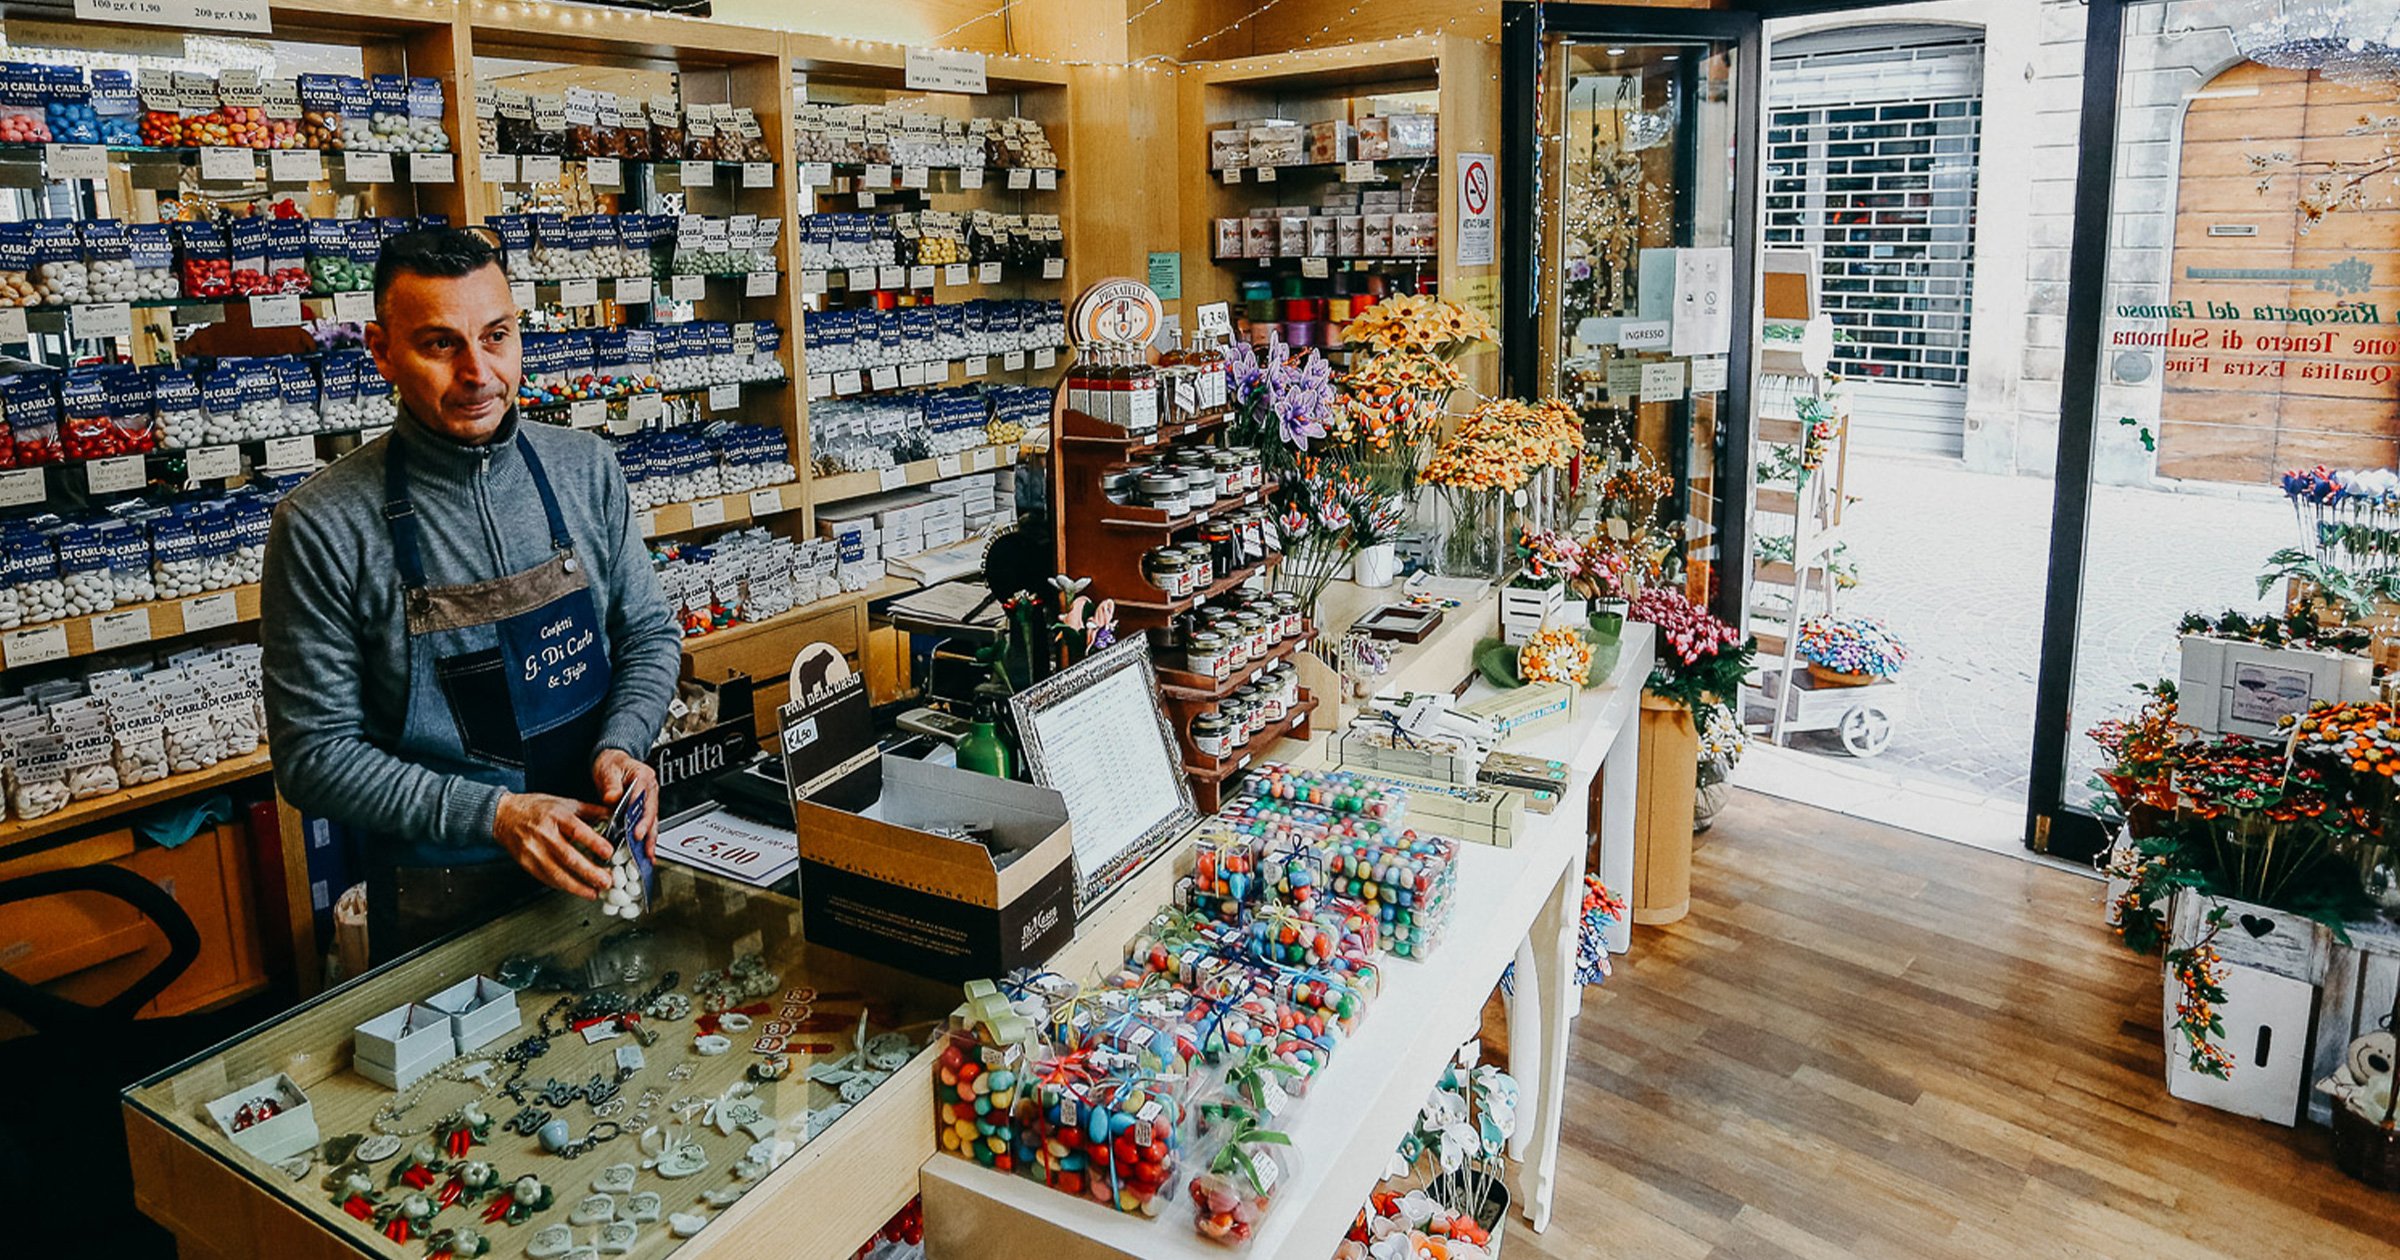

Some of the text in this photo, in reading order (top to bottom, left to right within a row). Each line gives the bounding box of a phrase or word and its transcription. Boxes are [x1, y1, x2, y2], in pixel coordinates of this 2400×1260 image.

[194, 7, 213, 17] 200
[0, 82, 47, 92] DI CARLO
[54, 84, 90, 93] CARLO
[220, 86, 263, 96] DI CARLO
[92, 89, 137, 99] DI CARLO
[303, 91, 341, 101] DI CARLO
[409, 94, 444, 103] DI CARLO
[346, 97, 373, 106] CARLO
[32, 237, 81, 248] DI CARLO
[85, 237, 130, 249] DI CARLO
[185, 239, 226, 249] DI CARLO
[233, 233, 268, 247] DI CARLO
[267, 235, 306, 247] DI CARLO
[310, 236, 348, 245] DI CARLO
[349, 240, 381, 250] DI CARLO
[1, 244, 36, 255] CARLO
[129, 242, 173, 252] DI CARLO
[1625, 329, 1664, 340] INGRESSO
[238, 377, 277, 389] DI CARLO
[324, 374, 357, 387] DI CARLO
[360, 374, 385, 383] DI CAR
[281, 379, 317, 391] DI CARLO
[110, 391, 152, 404] DI CARLO
[157, 387, 199, 399] DI CARLO
[204, 388, 242, 400] DI CARLO
[7, 397, 56, 414] DI CARLO
[64, 394, 108, 407] DI CARLO
[237, 520, 272, 534] DI CARL
[155, 535, 197, 550] DI CARLO
[198, 530, 236, 545] DI CARLO
[60, 546, 106, 560] DI CARLO
[106, 541, 149, 557] DI CARLO
[12, 559, 24, 570] DI
[25, 554, 57, 567] CARLO
[540, 616, 573, 640] Confetti
[541, 645, 566, 668] Di
[567, 628, 594, 657] Carlo
[548, 660, 587, 688] & Figlio
[209, 691, 252, 706] DI CARLO
[163, 702, 208, 719] DI CARLO
[784, 698, 806, 717] PAN
[114, 714, 162, 732] DI CARLO
[62, 735, 111, 752] DI CARLO
[2, 749, 14, 759] DI
[17, 752, 68, 768] DI CARLO
[658, 741, 725, 787] frutta
